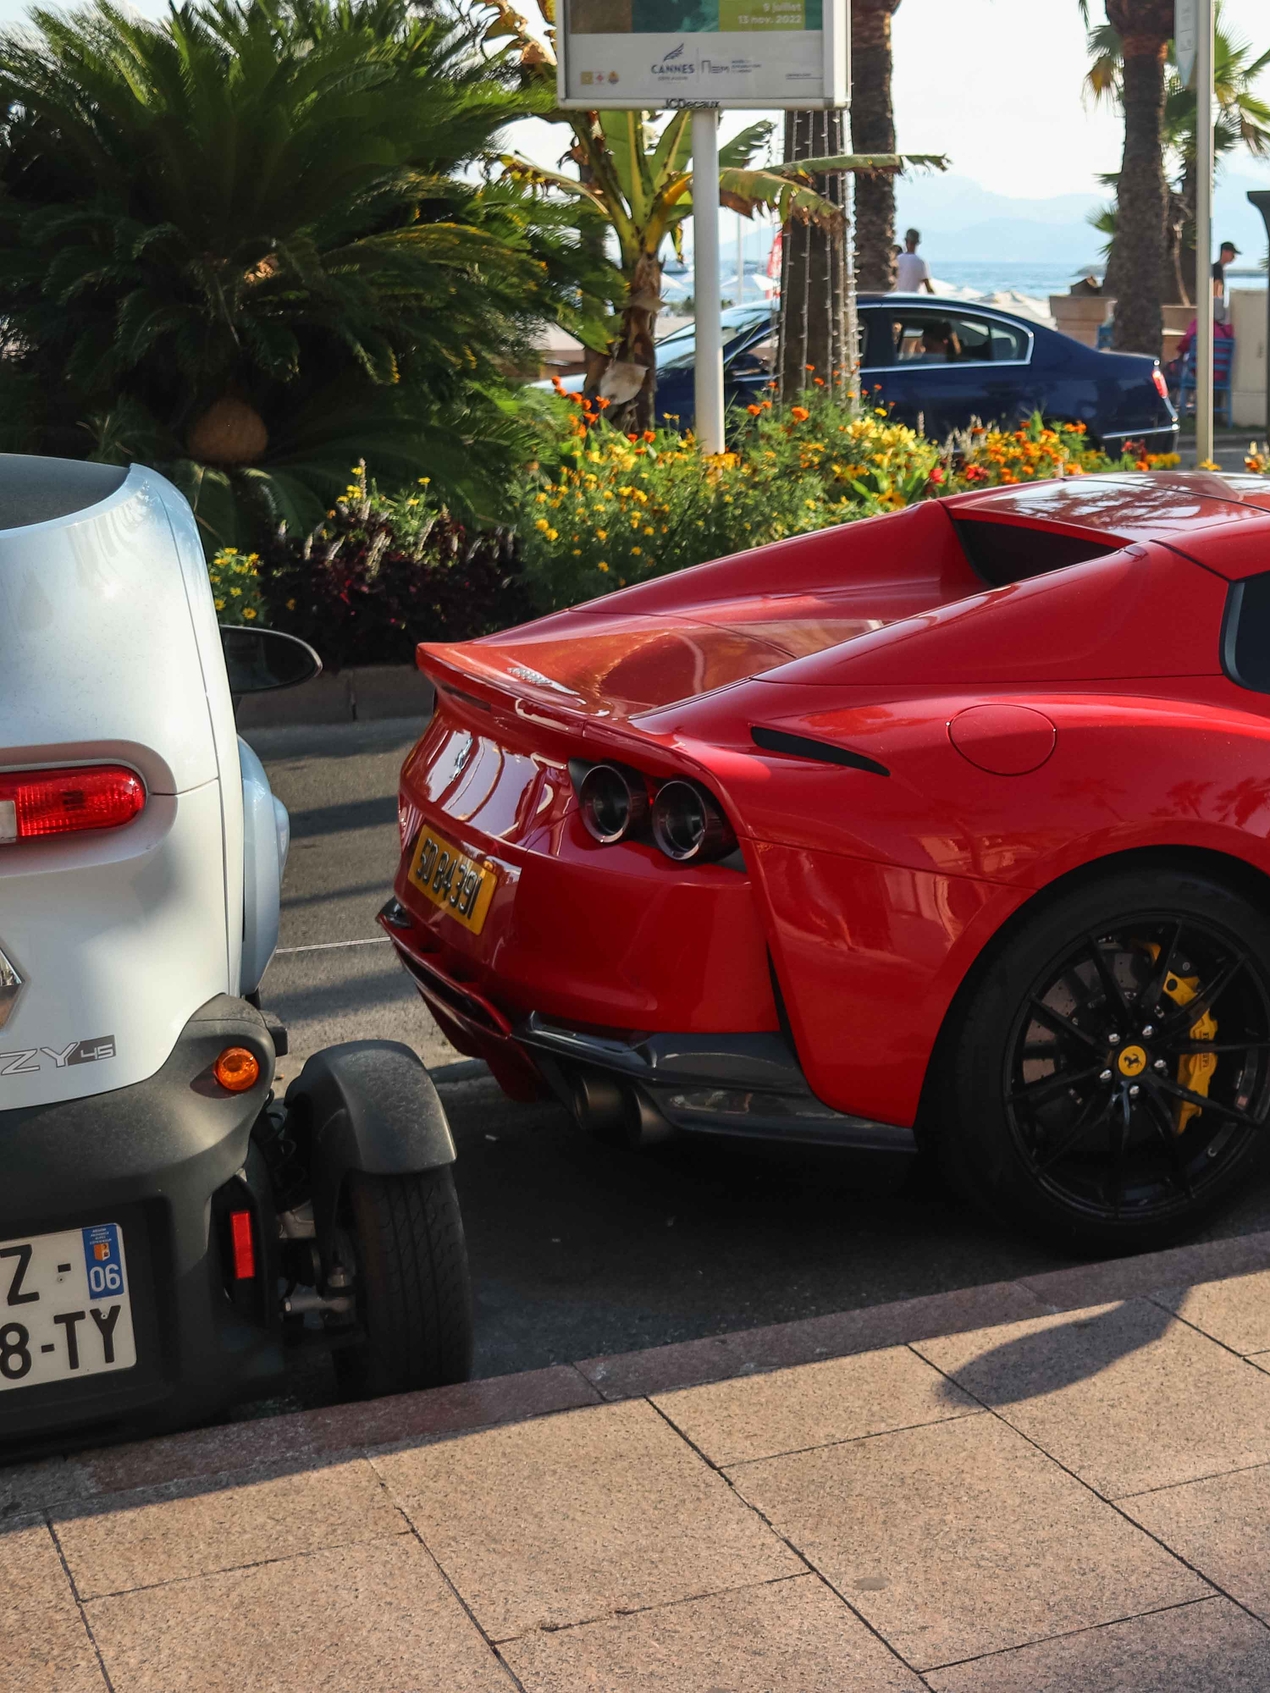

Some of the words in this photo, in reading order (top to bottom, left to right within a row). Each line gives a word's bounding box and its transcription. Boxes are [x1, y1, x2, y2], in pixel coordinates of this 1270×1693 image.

[776, 14, 802, 24] 2022
[651, 63, 695, 74] CANNES
[662, 98, 721, 109] JCDecaux
[89, 1263, 122, 1292] 06
